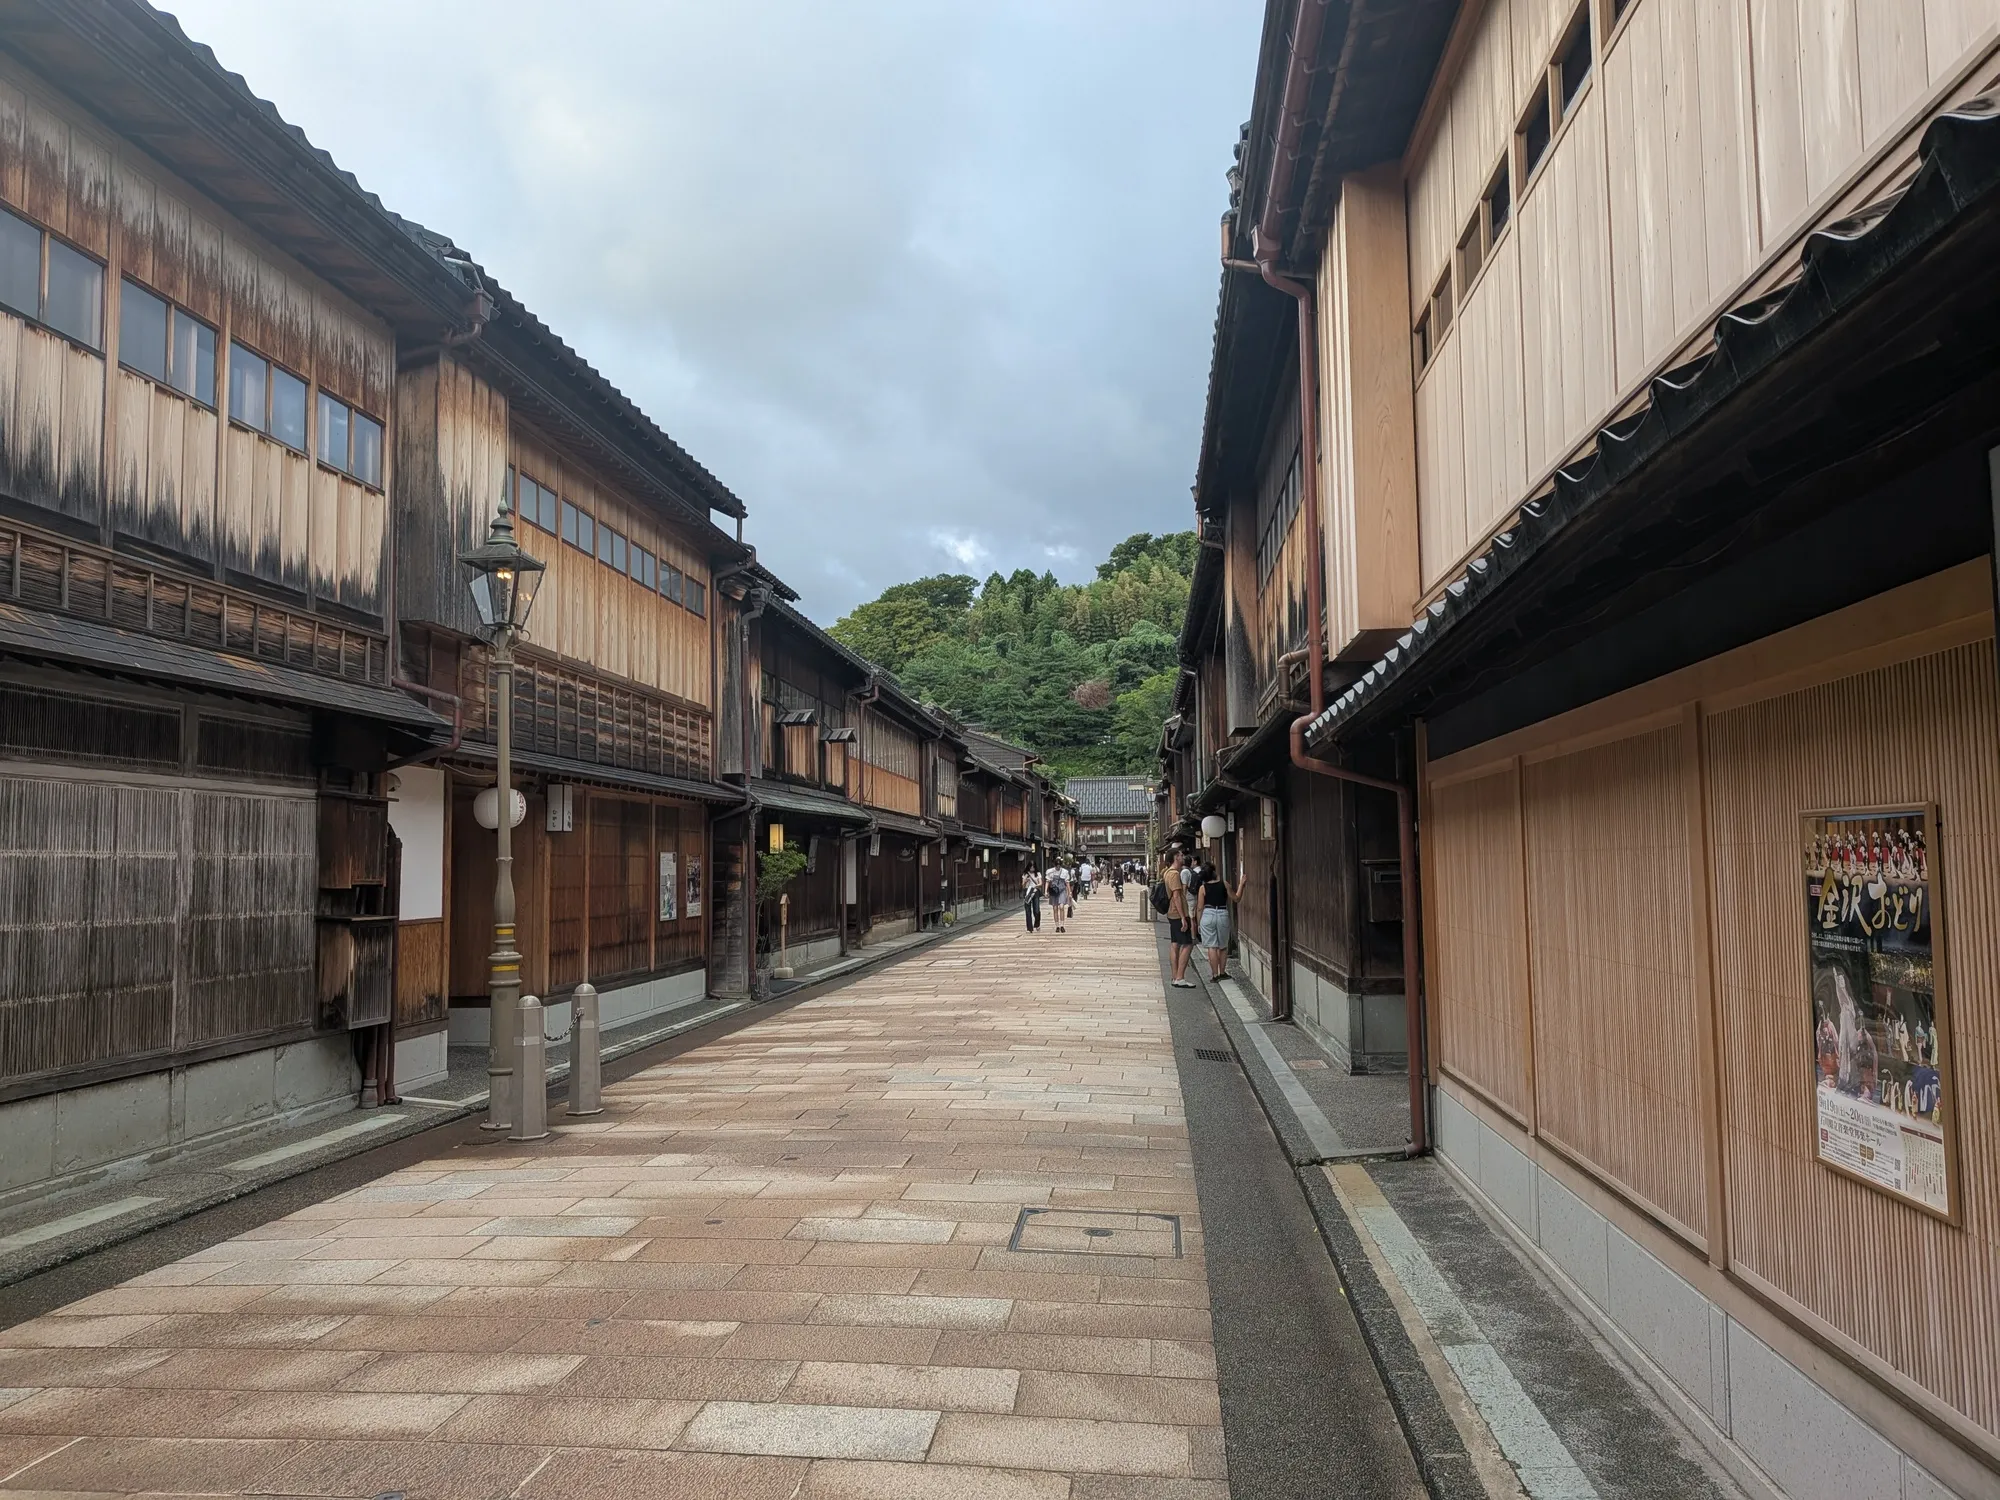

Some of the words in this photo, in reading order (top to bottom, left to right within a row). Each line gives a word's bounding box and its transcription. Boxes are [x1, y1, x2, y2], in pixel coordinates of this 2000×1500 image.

[1817, 867, 1923, 936] 金沢おどり
